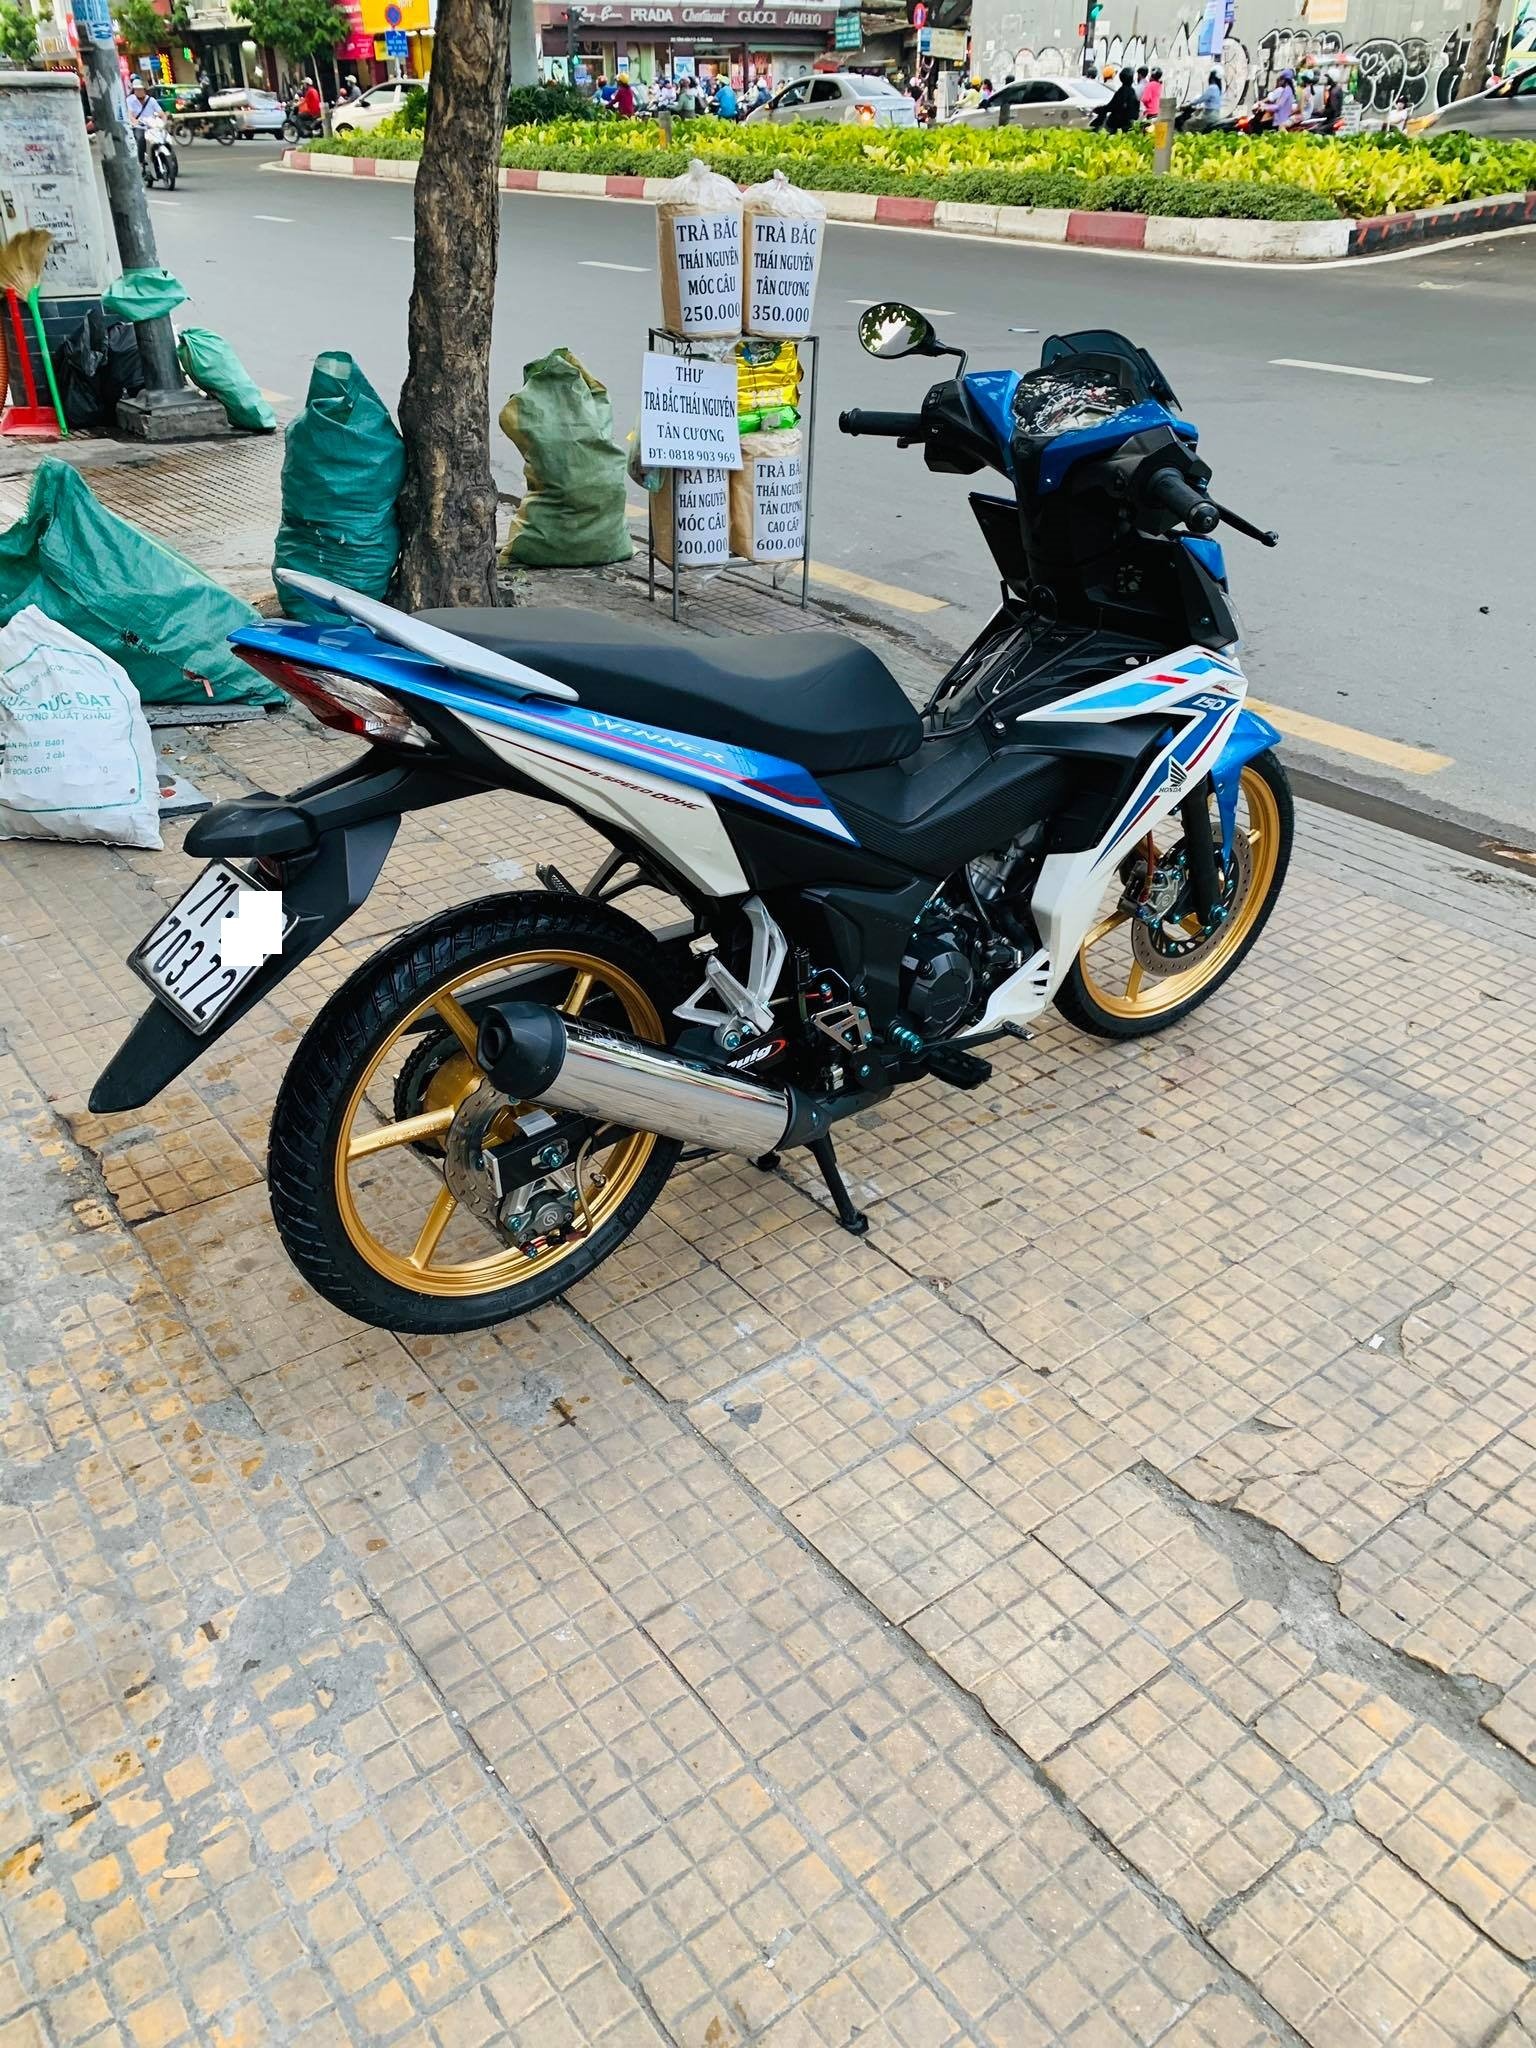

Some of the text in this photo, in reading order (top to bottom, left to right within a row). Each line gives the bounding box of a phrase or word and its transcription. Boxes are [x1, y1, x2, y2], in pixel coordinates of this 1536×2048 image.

[631, 8, 673, 22] PRADA
[738, 11, 776, 24] GUCCI
[677, 216, 738, 242] TRÀ BẮC
[756, 221, 816, 244] TRÀ BẮC
[679, 249, 704, 269] THÁI
[754, 250, 814, 271] THÁI NGUYÊN
[688, 273, 736, 295] MÓC CÂU
[757, 276, 810, 296] TÂN CƯƠNG
[684, 303, 740, 322] 250.000
[753, 305, 809, 322] 350.000
[675, 366, 704, 384] THƯ
[644, 387, 661, 411] TRÀ
[662, 387, 679, 413] BẮC
[680, 393, 700, 415] THÁI
[702, 395, 735, 418] NGUYÊN
[657, 421, 725, 442] TÂN CƯƠNG
[649, 448, 735, 463] ĐT: 0818 903 969
[757, 461, 785, 478] TRÀ
[679, 489, 696, 508] HÁI
[756, 482, 779, 497] THÁI
[760, 501, 778, 515] TÂN
[677, 512, 726, 531] MÓC CÂU
[767, 521, 786, 533] CAO
[677, 538, 728, 554] 200.000
[1192, 696, 1227, 711] 150
[590, 713, 726, 764] WINNER
[589, 770, 704, 810] 6 SPEED DOHC
[141, 915, 237, 1020] 703.72
